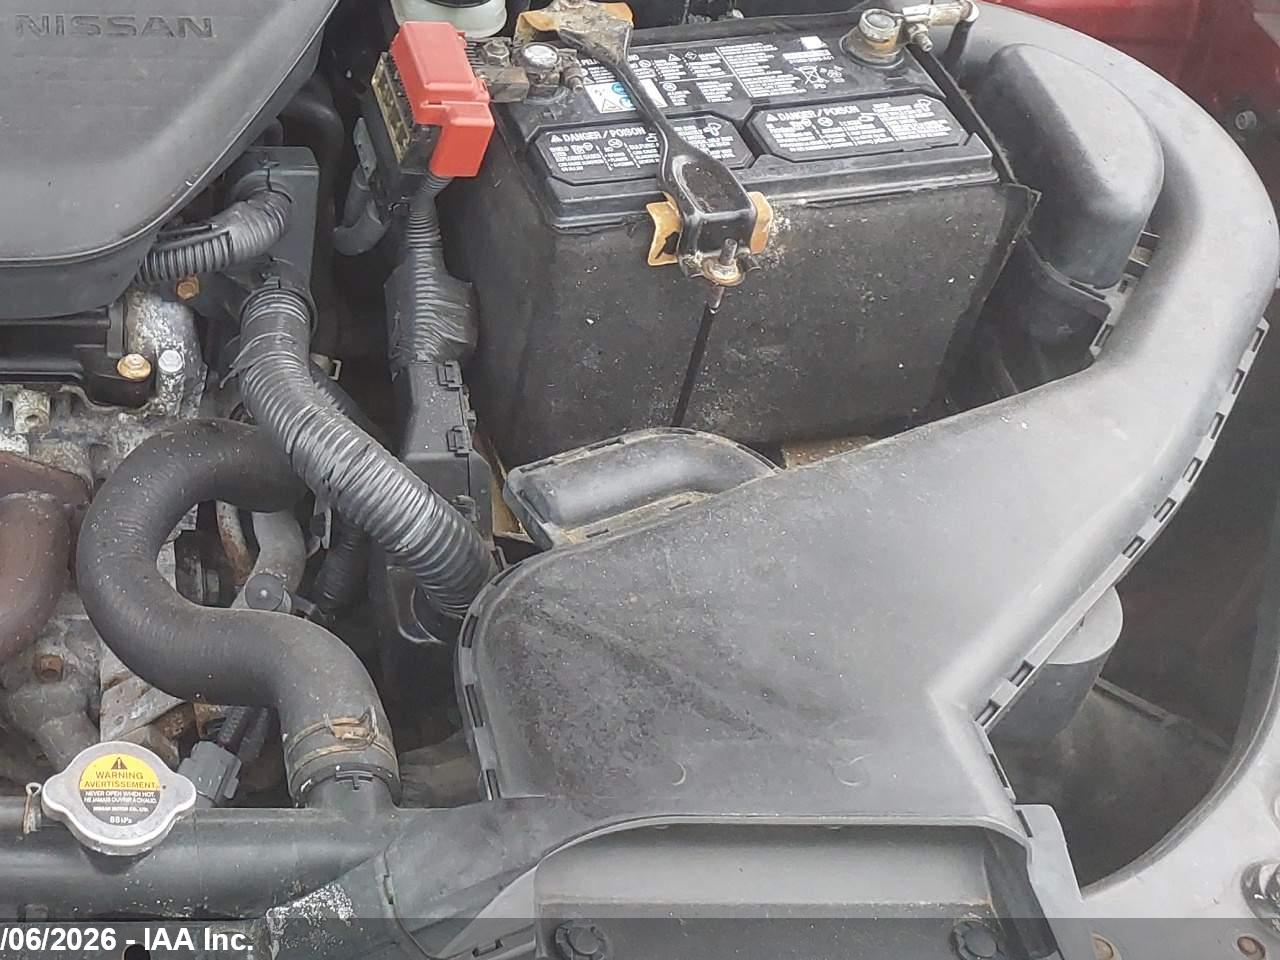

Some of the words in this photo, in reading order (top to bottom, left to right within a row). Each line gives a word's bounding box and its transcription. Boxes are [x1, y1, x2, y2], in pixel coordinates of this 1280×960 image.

[15, 15, 214, 38] NISSAN
[777, 110, 817, 121] DANGER
[823, 105, 860, 116] POISON
[562, 131, 602, 142] DANGER
[609, 127, 646, 138] POISON
[96, 771, 143, 779] WARNING
[84, 780, 155, 788] AVERTISSEMENT
